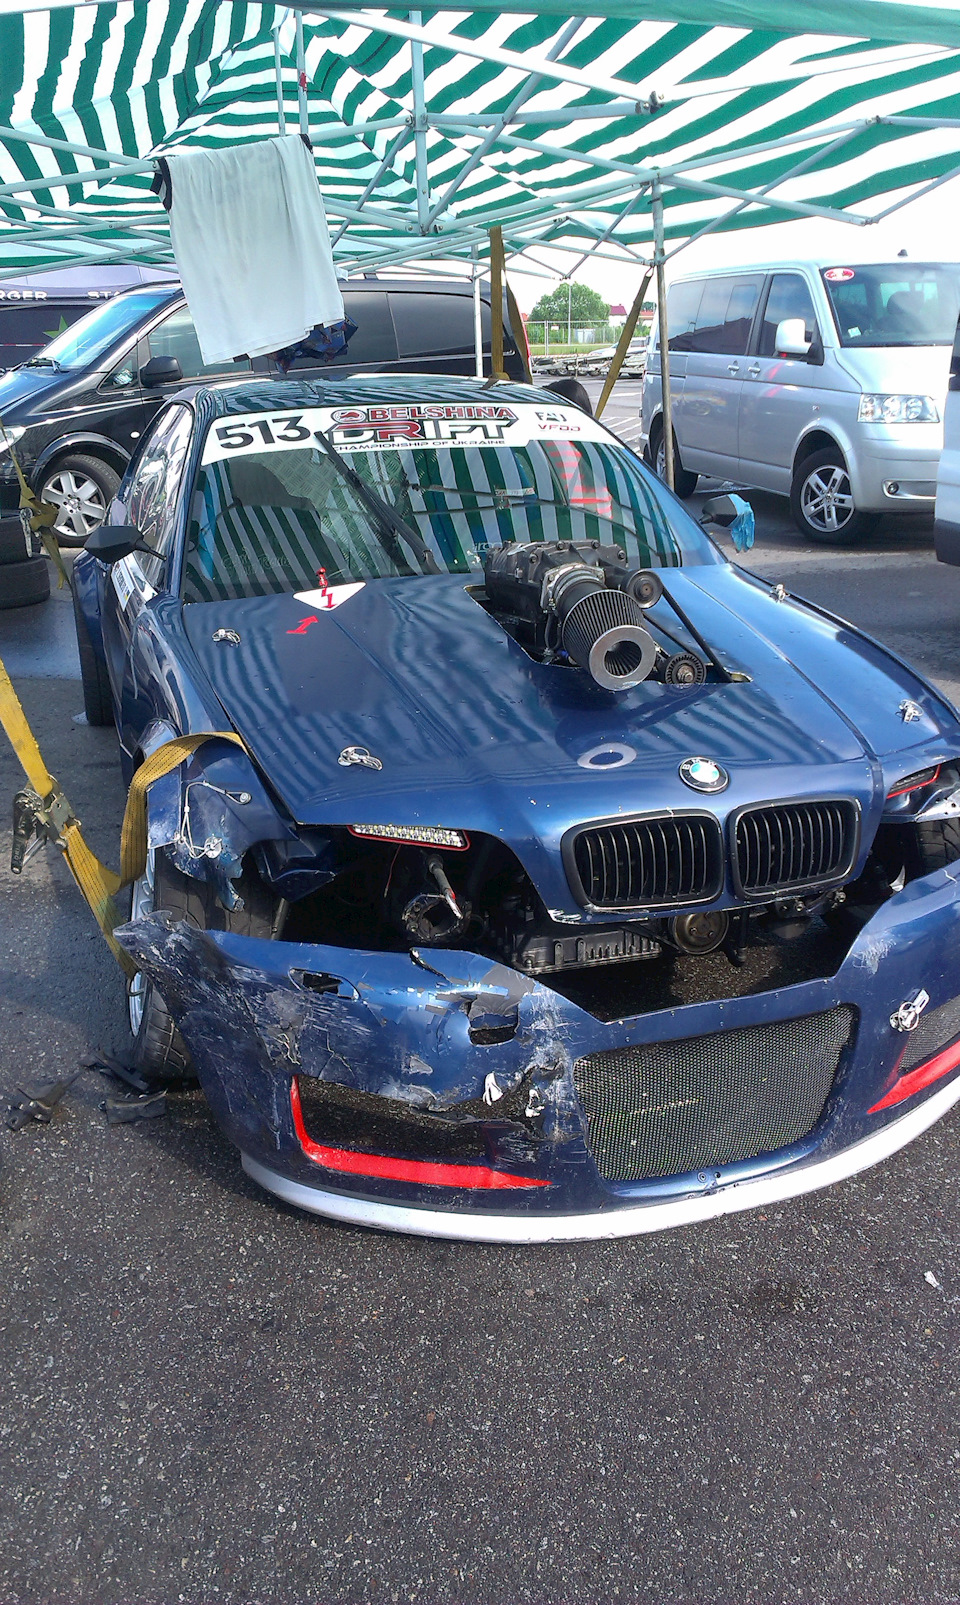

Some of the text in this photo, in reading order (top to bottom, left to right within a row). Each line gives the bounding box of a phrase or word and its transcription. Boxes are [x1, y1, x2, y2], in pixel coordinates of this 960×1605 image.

[369, 406, 517, 421] BELSHINA
[215, 415, 311, 449] 513
[326, 418, 518, 446] DRIFT
